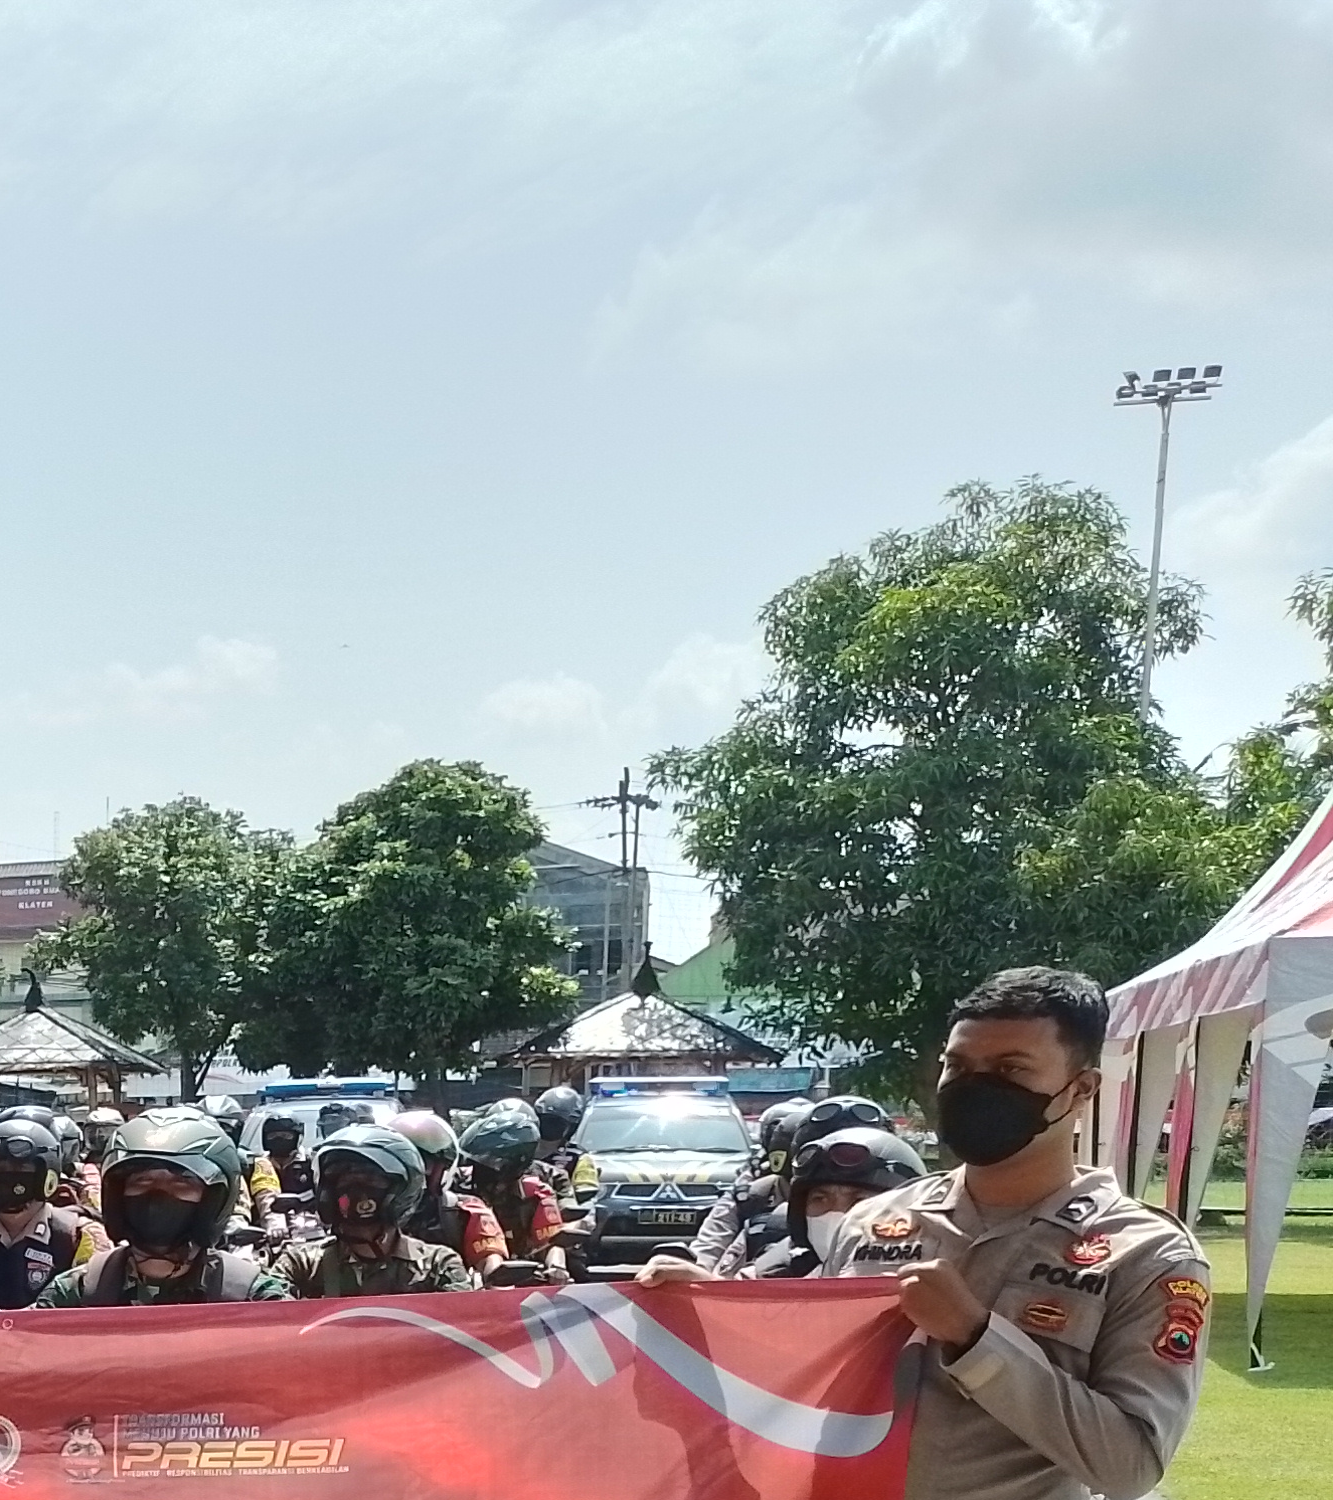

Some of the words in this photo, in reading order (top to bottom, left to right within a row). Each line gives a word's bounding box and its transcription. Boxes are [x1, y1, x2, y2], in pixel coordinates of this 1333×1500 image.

[1029, 1262, 1107, 1295] POLRI
[180, 1427, 221, 1439] POLRI
[223, 1426, 260, 1439] YANG
[121, 1438, 345, 1470] PRESISI
